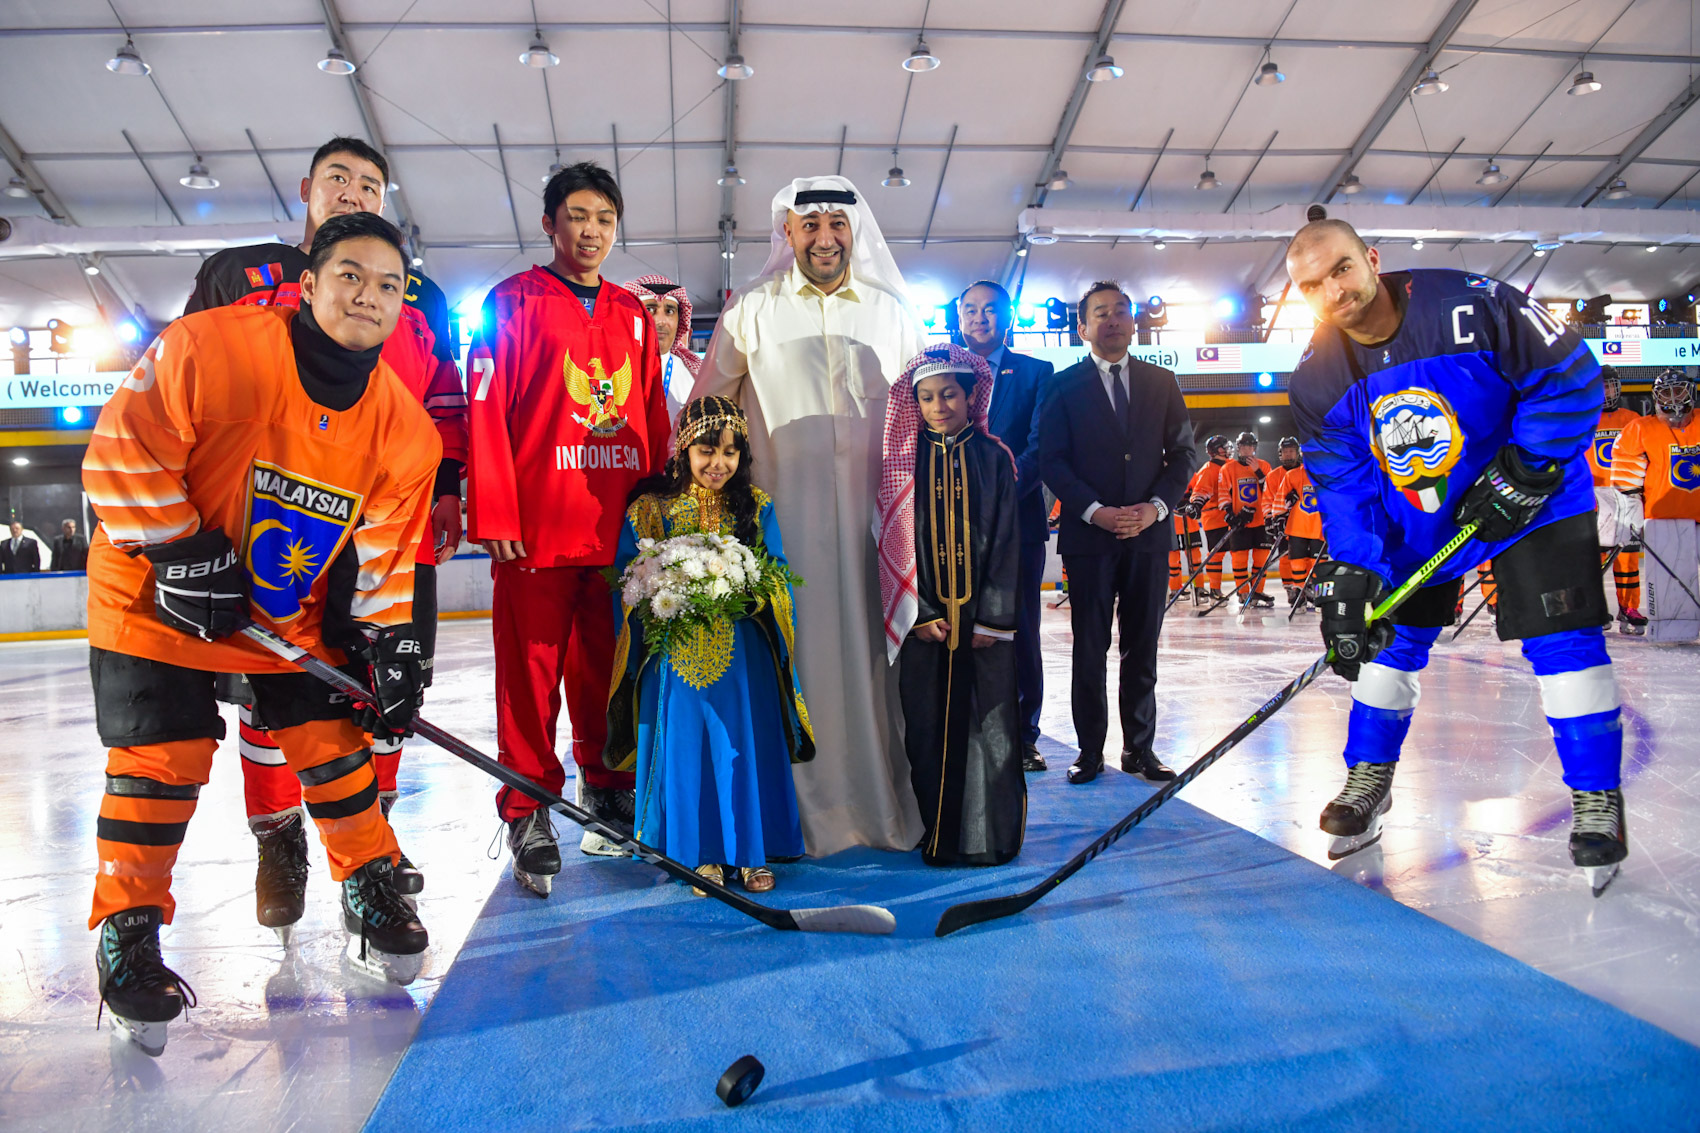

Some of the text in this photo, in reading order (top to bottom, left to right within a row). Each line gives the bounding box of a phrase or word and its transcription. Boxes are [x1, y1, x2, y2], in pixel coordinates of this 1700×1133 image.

[1451, 304, 1475, 345] C
[1519, 297, 1566, 347] 10
[20, 380, 114, 398] Welcome
[473, 358, 495, 401] 7
[1594, 430, 1622, 439] MALAYS
[253, 468, 349, 519] MALAYSIA
[1487, 466, 1550, 507] WARRI
[550, 802, 664, 864] CCM
[124, 913, 150, 928] JUN
